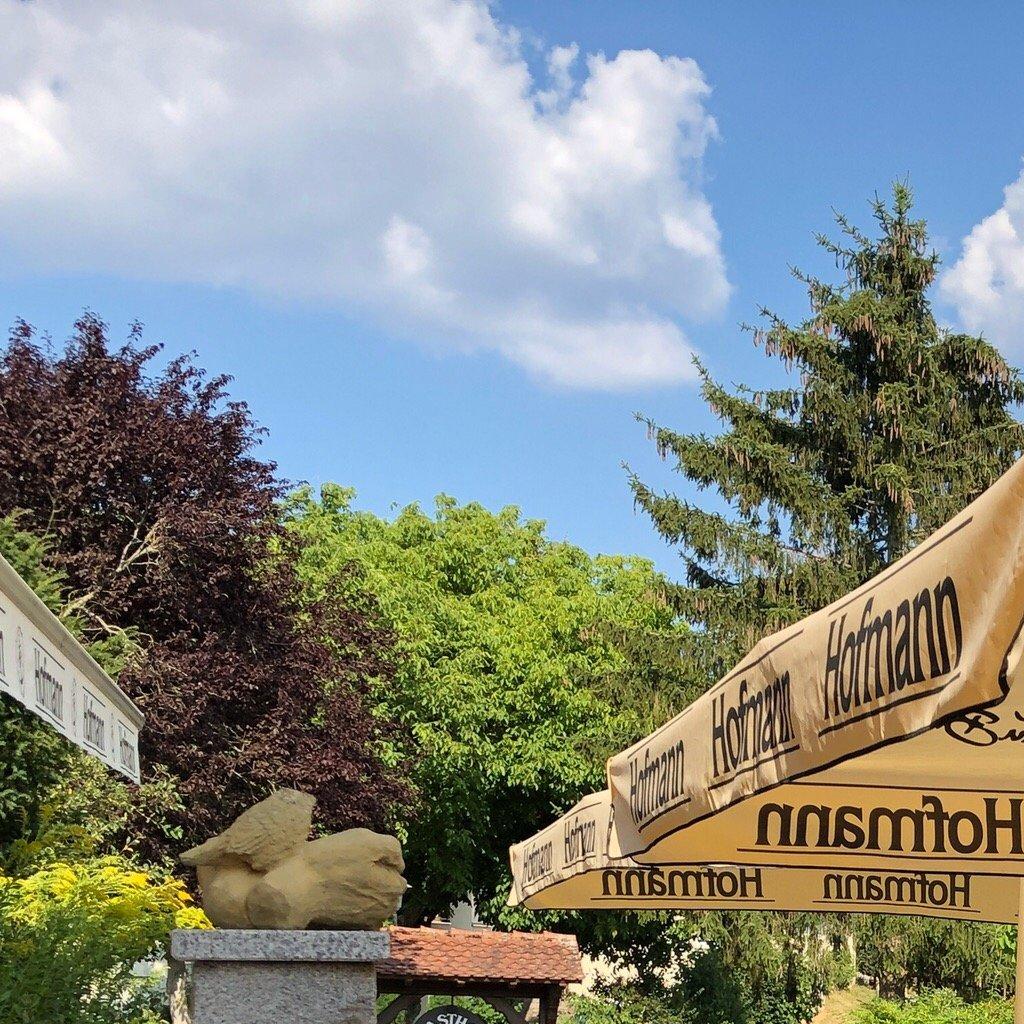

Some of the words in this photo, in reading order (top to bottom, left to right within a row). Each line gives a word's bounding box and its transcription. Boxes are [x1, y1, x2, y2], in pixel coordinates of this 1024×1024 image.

[825, 576, 963, 720] Hofmann
[713, 670, 795, 778] Hofmann
[630, 739, 684, 825] Hofmann
